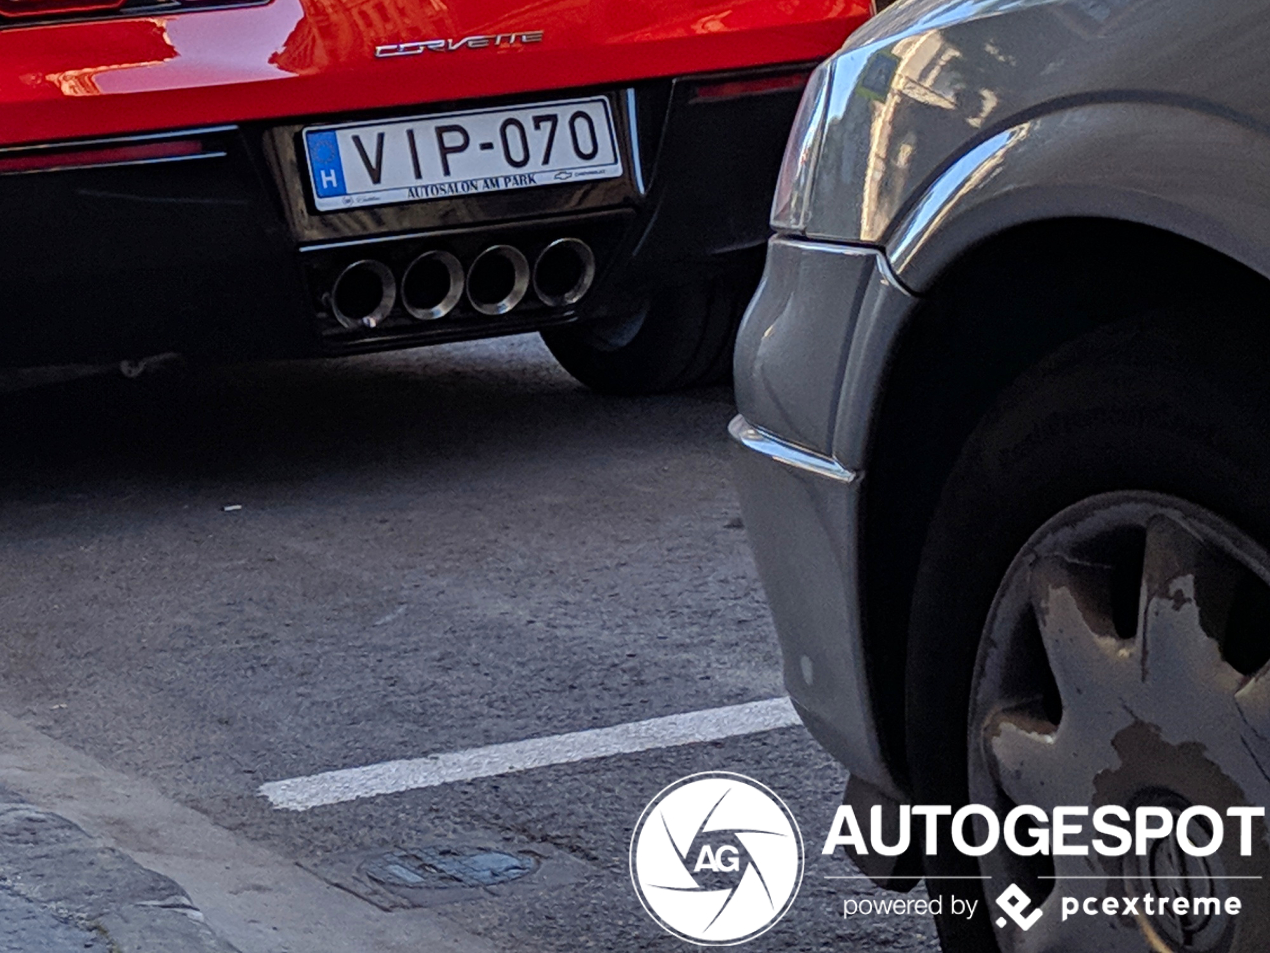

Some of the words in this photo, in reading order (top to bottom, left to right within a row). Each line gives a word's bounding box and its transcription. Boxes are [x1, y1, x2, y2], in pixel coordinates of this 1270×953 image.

[375, 30, 544, 58] CORVETTE
[351, 110, 598, 185] VIP-070
[320, 168, 338, 189] H
[407, 181, 479, 199] AUTOSALON
[482, 178, 500, 190] AM
[504, 173, 537, 188] PARK
